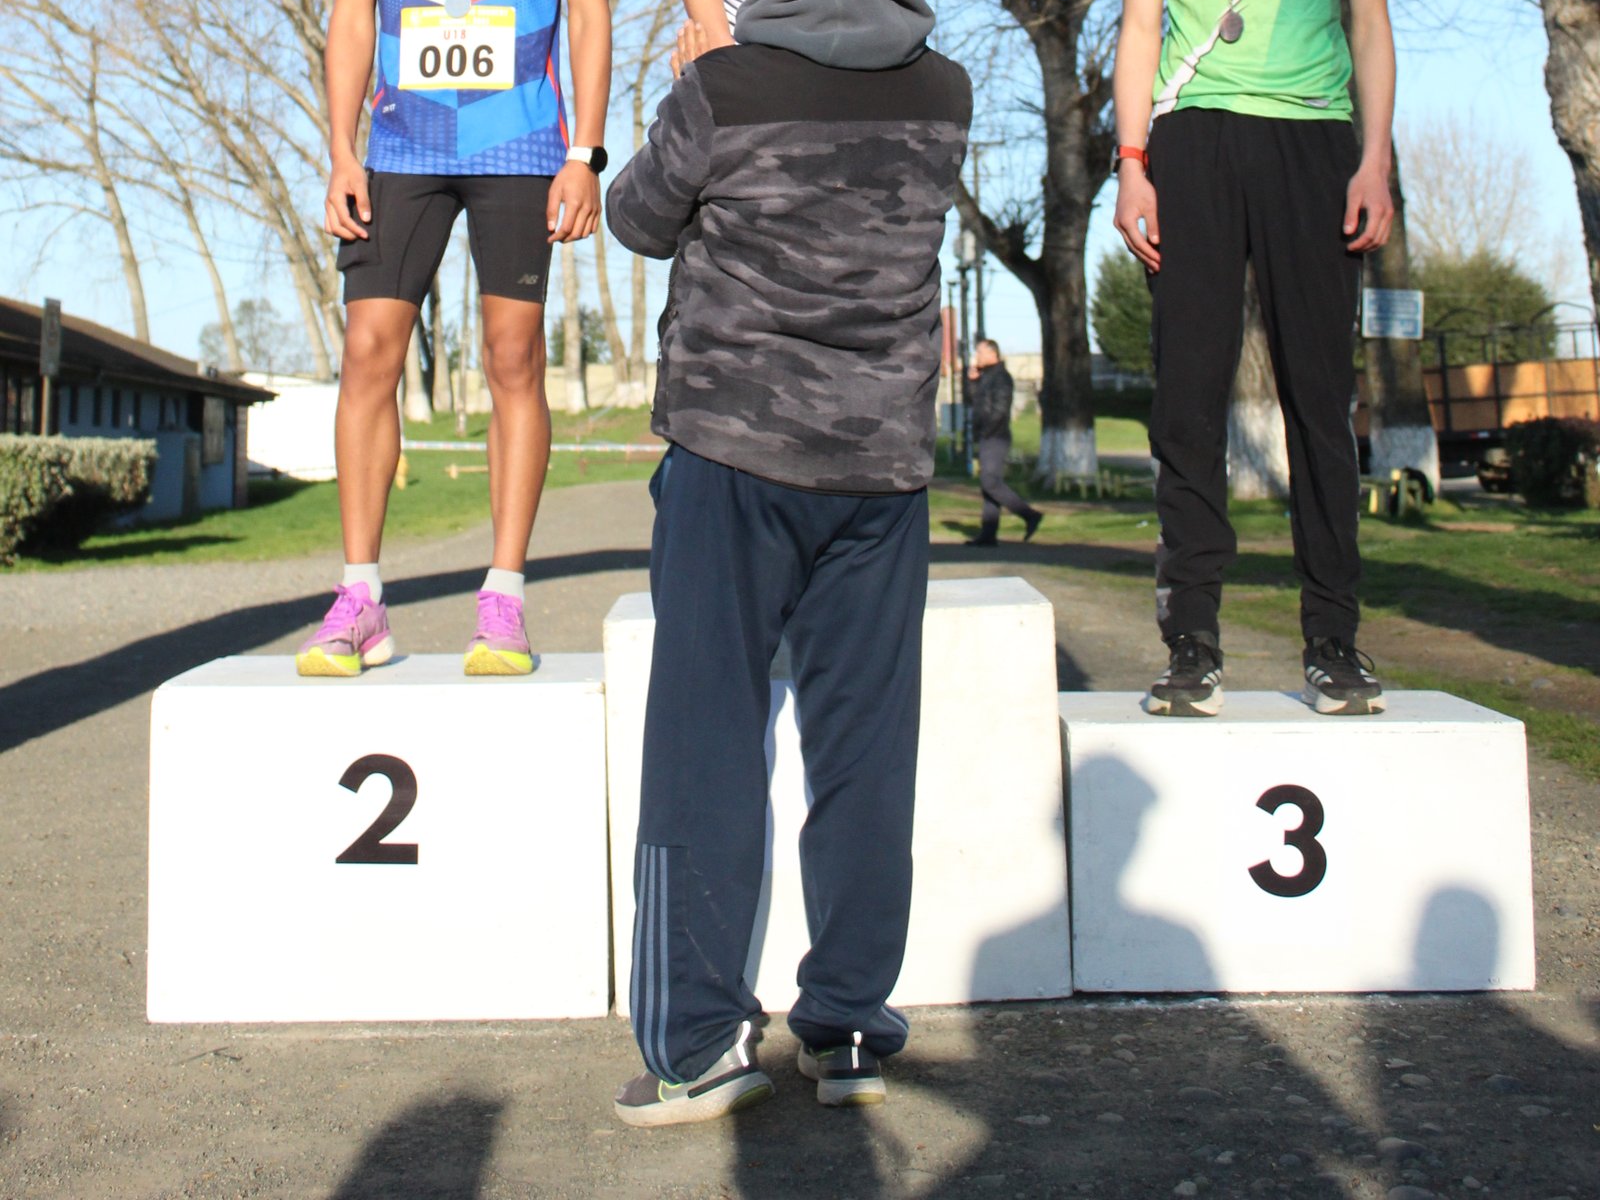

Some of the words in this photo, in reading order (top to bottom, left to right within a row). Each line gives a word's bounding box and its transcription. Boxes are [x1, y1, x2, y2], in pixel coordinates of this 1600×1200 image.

[419, 44, 494, 78] 006
[443, 29, 466, 40] U18
[335, 753, 419, 865] 2
[1247, 783, 1328, 898] 3
